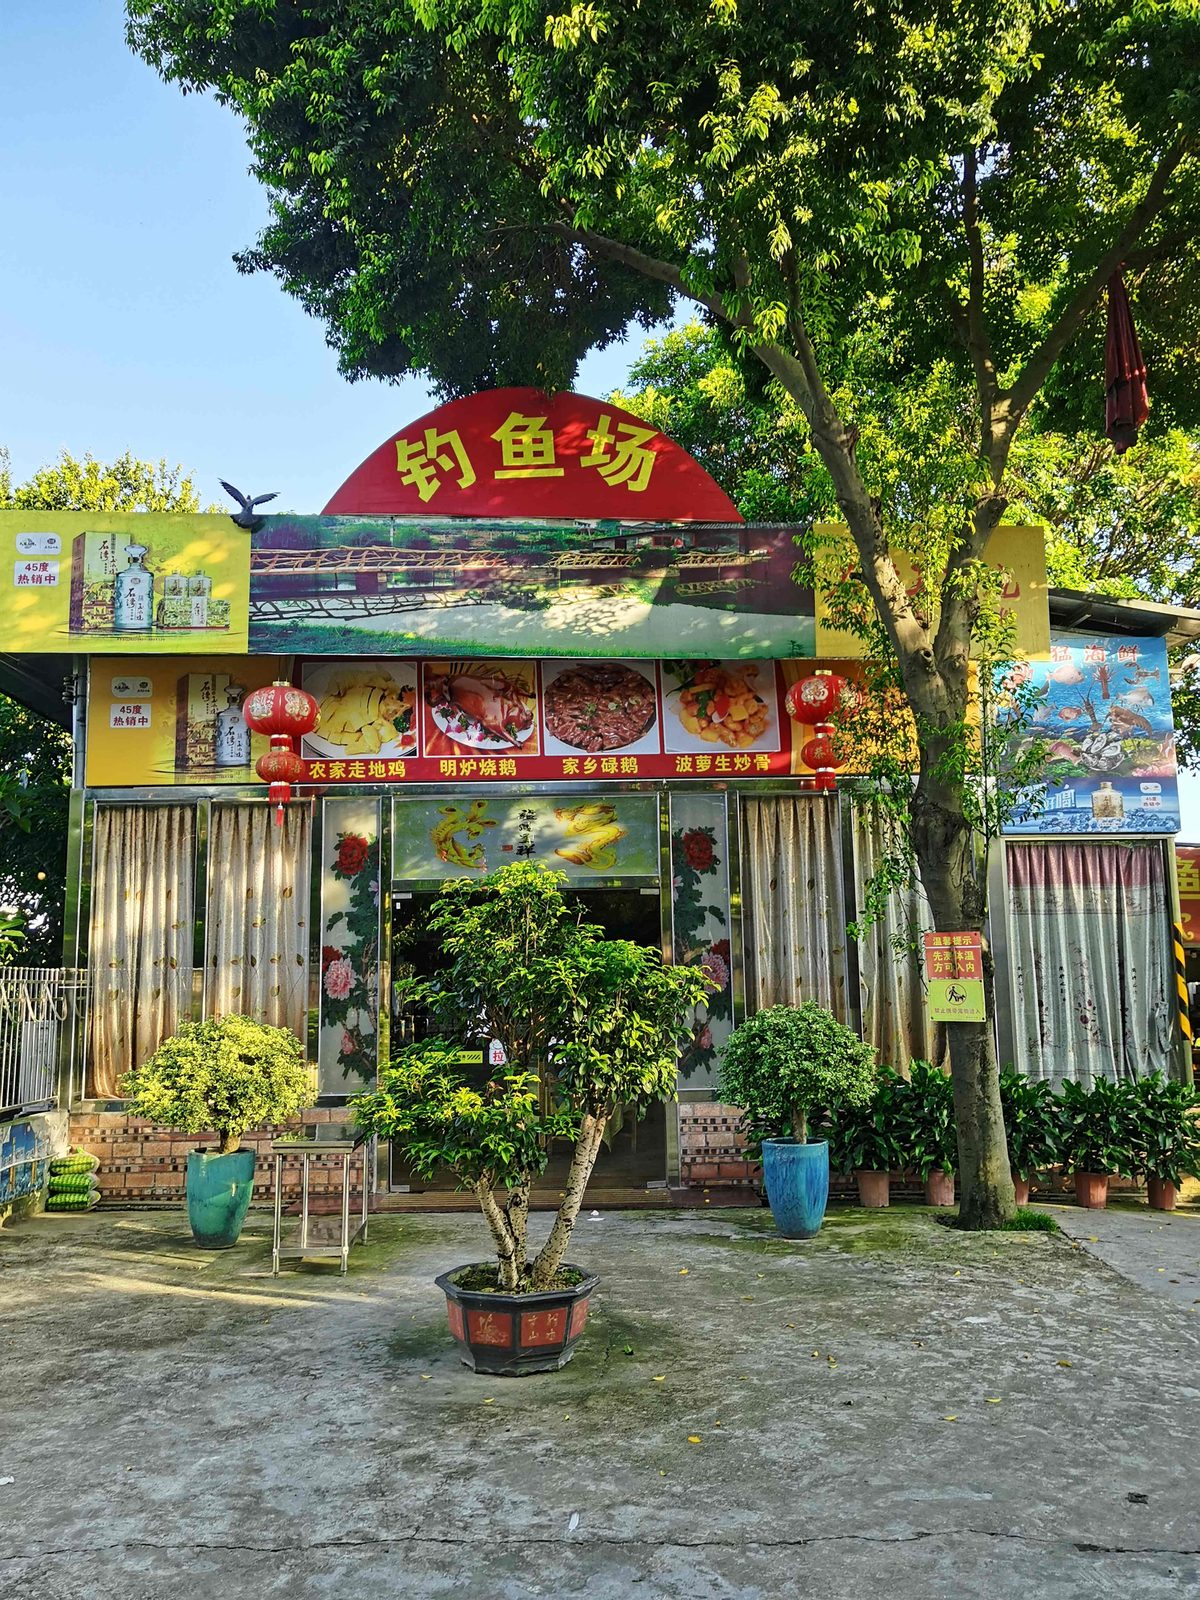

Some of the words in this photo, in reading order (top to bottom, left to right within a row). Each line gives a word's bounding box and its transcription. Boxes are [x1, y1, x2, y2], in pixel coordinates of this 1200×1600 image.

[394, 411, 659, 503] 钓鱼场
[24, 562, 49, 572] 45度
[17, 574, 56, 584] 热销中
[119, 704, 142, 714] 45度
[113, 716, 148, 726] 热销中
[308, 759, 407, 780] 农家走地鸡
[439, 757, 517, 778] 明炉烧鹅
[561, 755, 640, 776] 家乡碌鹅
[932, 936, 972, 946] 温馨提示
[493, 1051, 504, 1062] 拉
